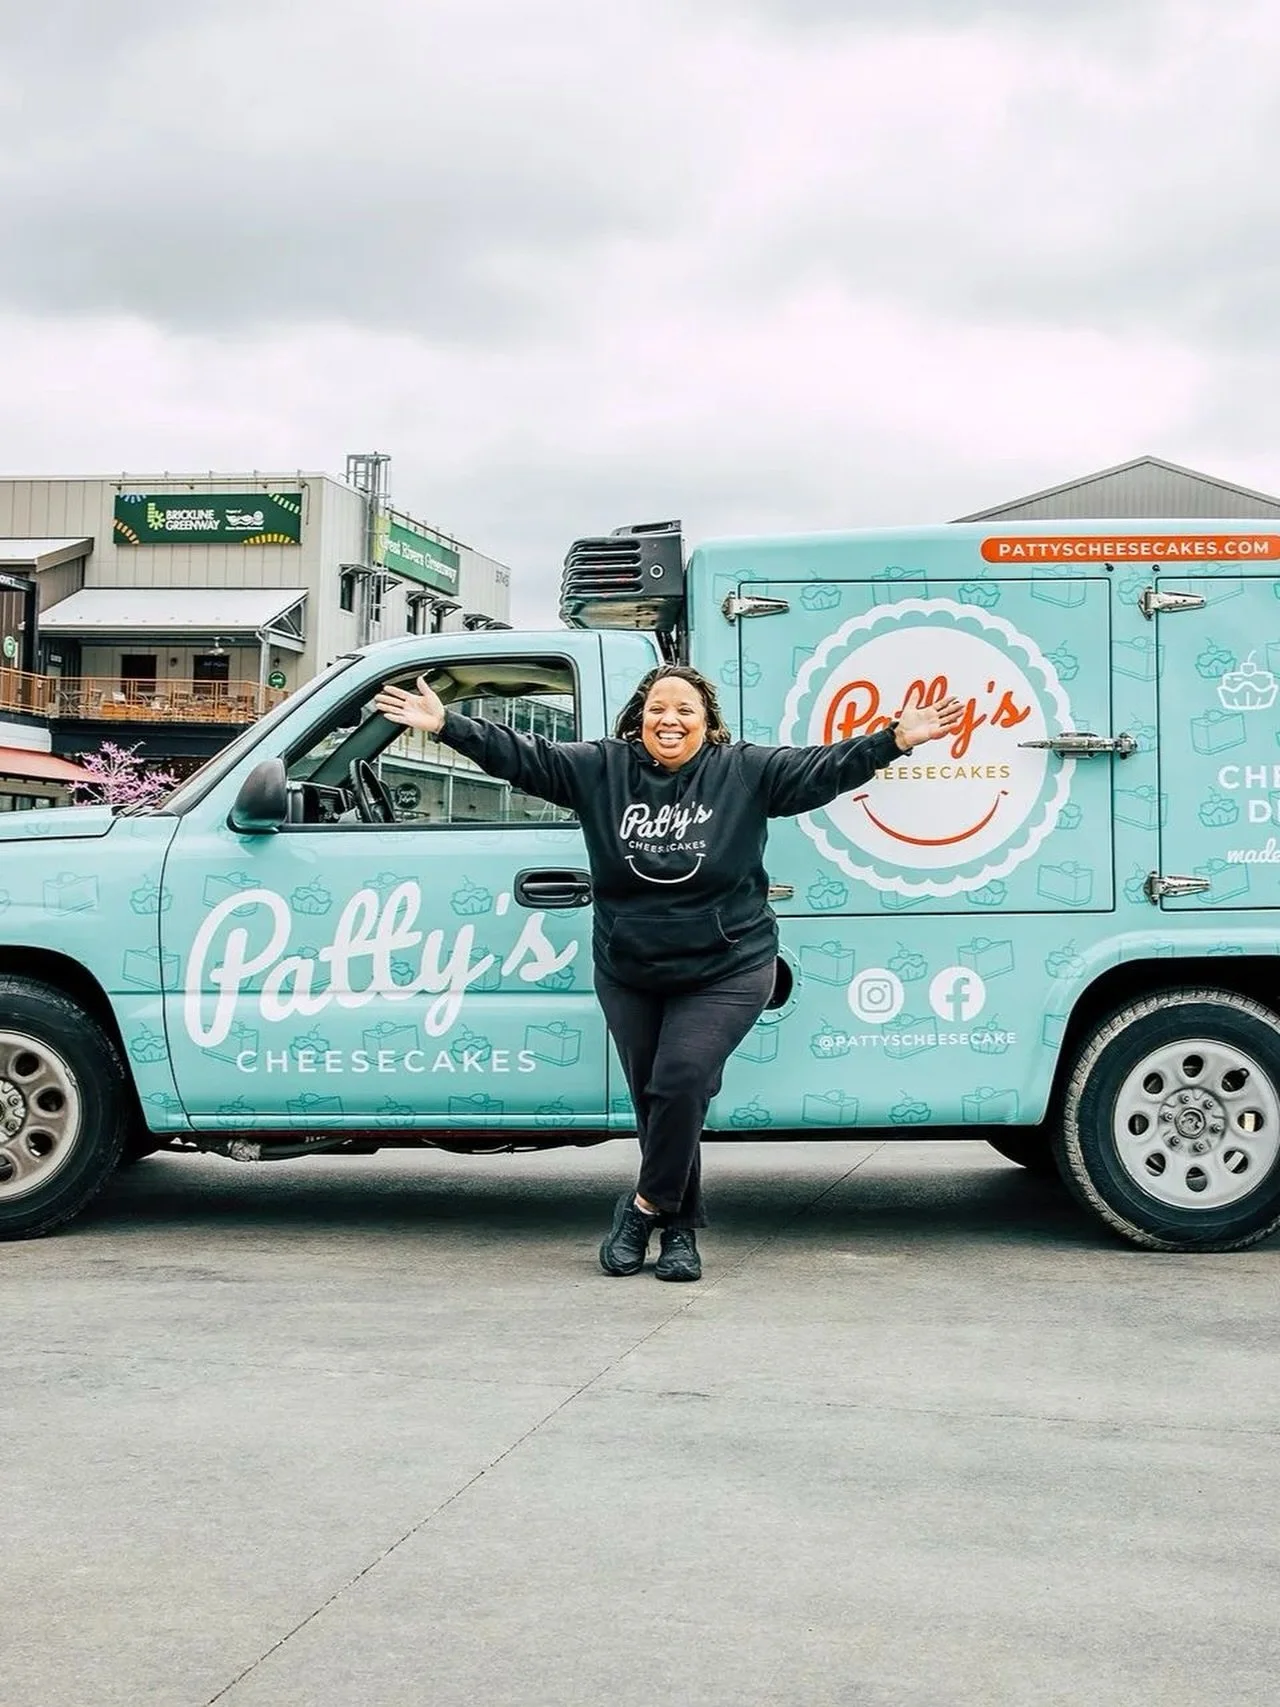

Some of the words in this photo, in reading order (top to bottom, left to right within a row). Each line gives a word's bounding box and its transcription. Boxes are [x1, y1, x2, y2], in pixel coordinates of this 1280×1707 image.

[165, 509, 215, 520] BRICKLINE
[165, 519, 221, 531] GREENWAY
[998, 540, 1270, 557] PATTYSCHEESECAKES.COM
[823, 675, 1031, 760] Py's
[874, 765, 1011, 781] EESECAKES
[1248, 799, 1280, 823] D
[184, 881, 579, 1047] Patty's
[819, 1032, 1018, 1050] @PATTYSCHEESECAKE
[236, 1049, 538, 1074] CHEESECAKES
